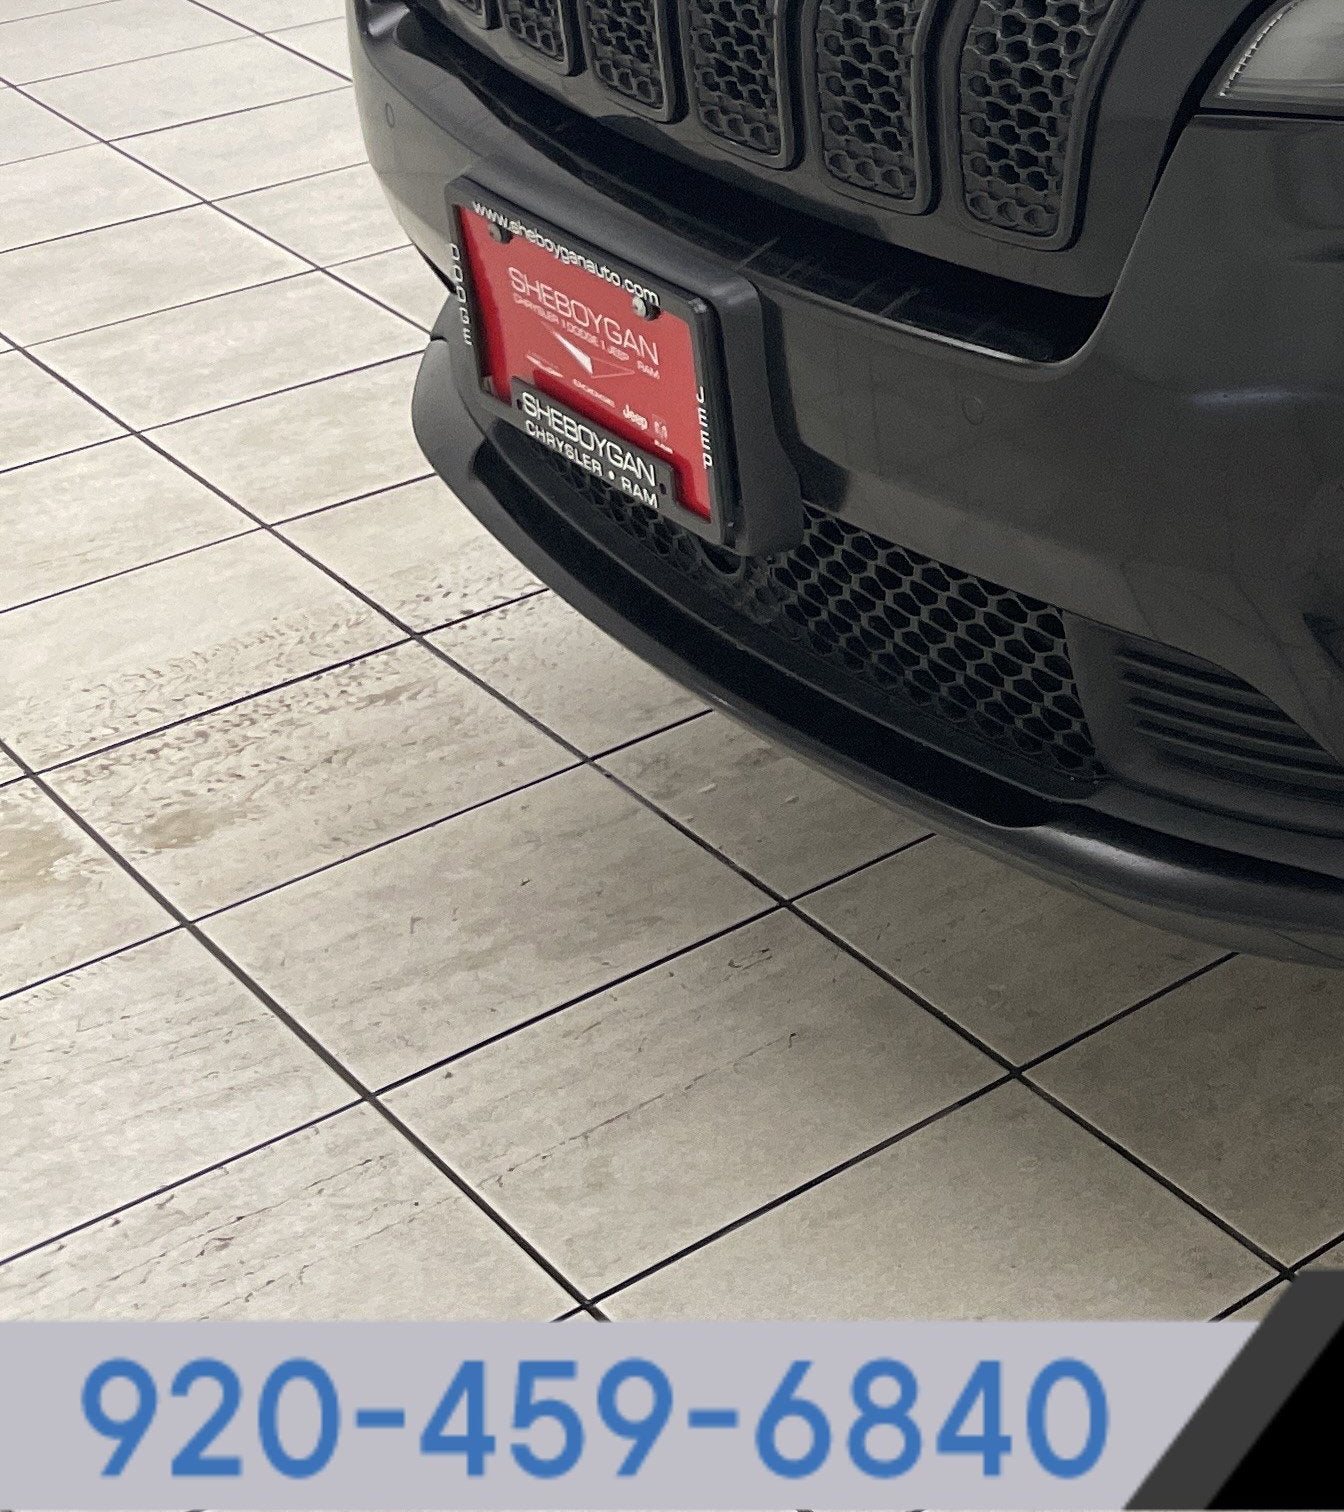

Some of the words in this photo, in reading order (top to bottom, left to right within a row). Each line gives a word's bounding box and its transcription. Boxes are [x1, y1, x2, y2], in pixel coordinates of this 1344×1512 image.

[450, 242, 474, 346] DODGE
[472, 200, 660, 306] www.sheboyganauto.com
[508, 266, 660, 366] SHEBOYGAN
[522, 391, 657, 487] SHEBOYGAN
[525, 419, 603, 477] CHRYSLER
[621, 475, 658, 509] RAM
[696, 385, 713, 470] JEEP
